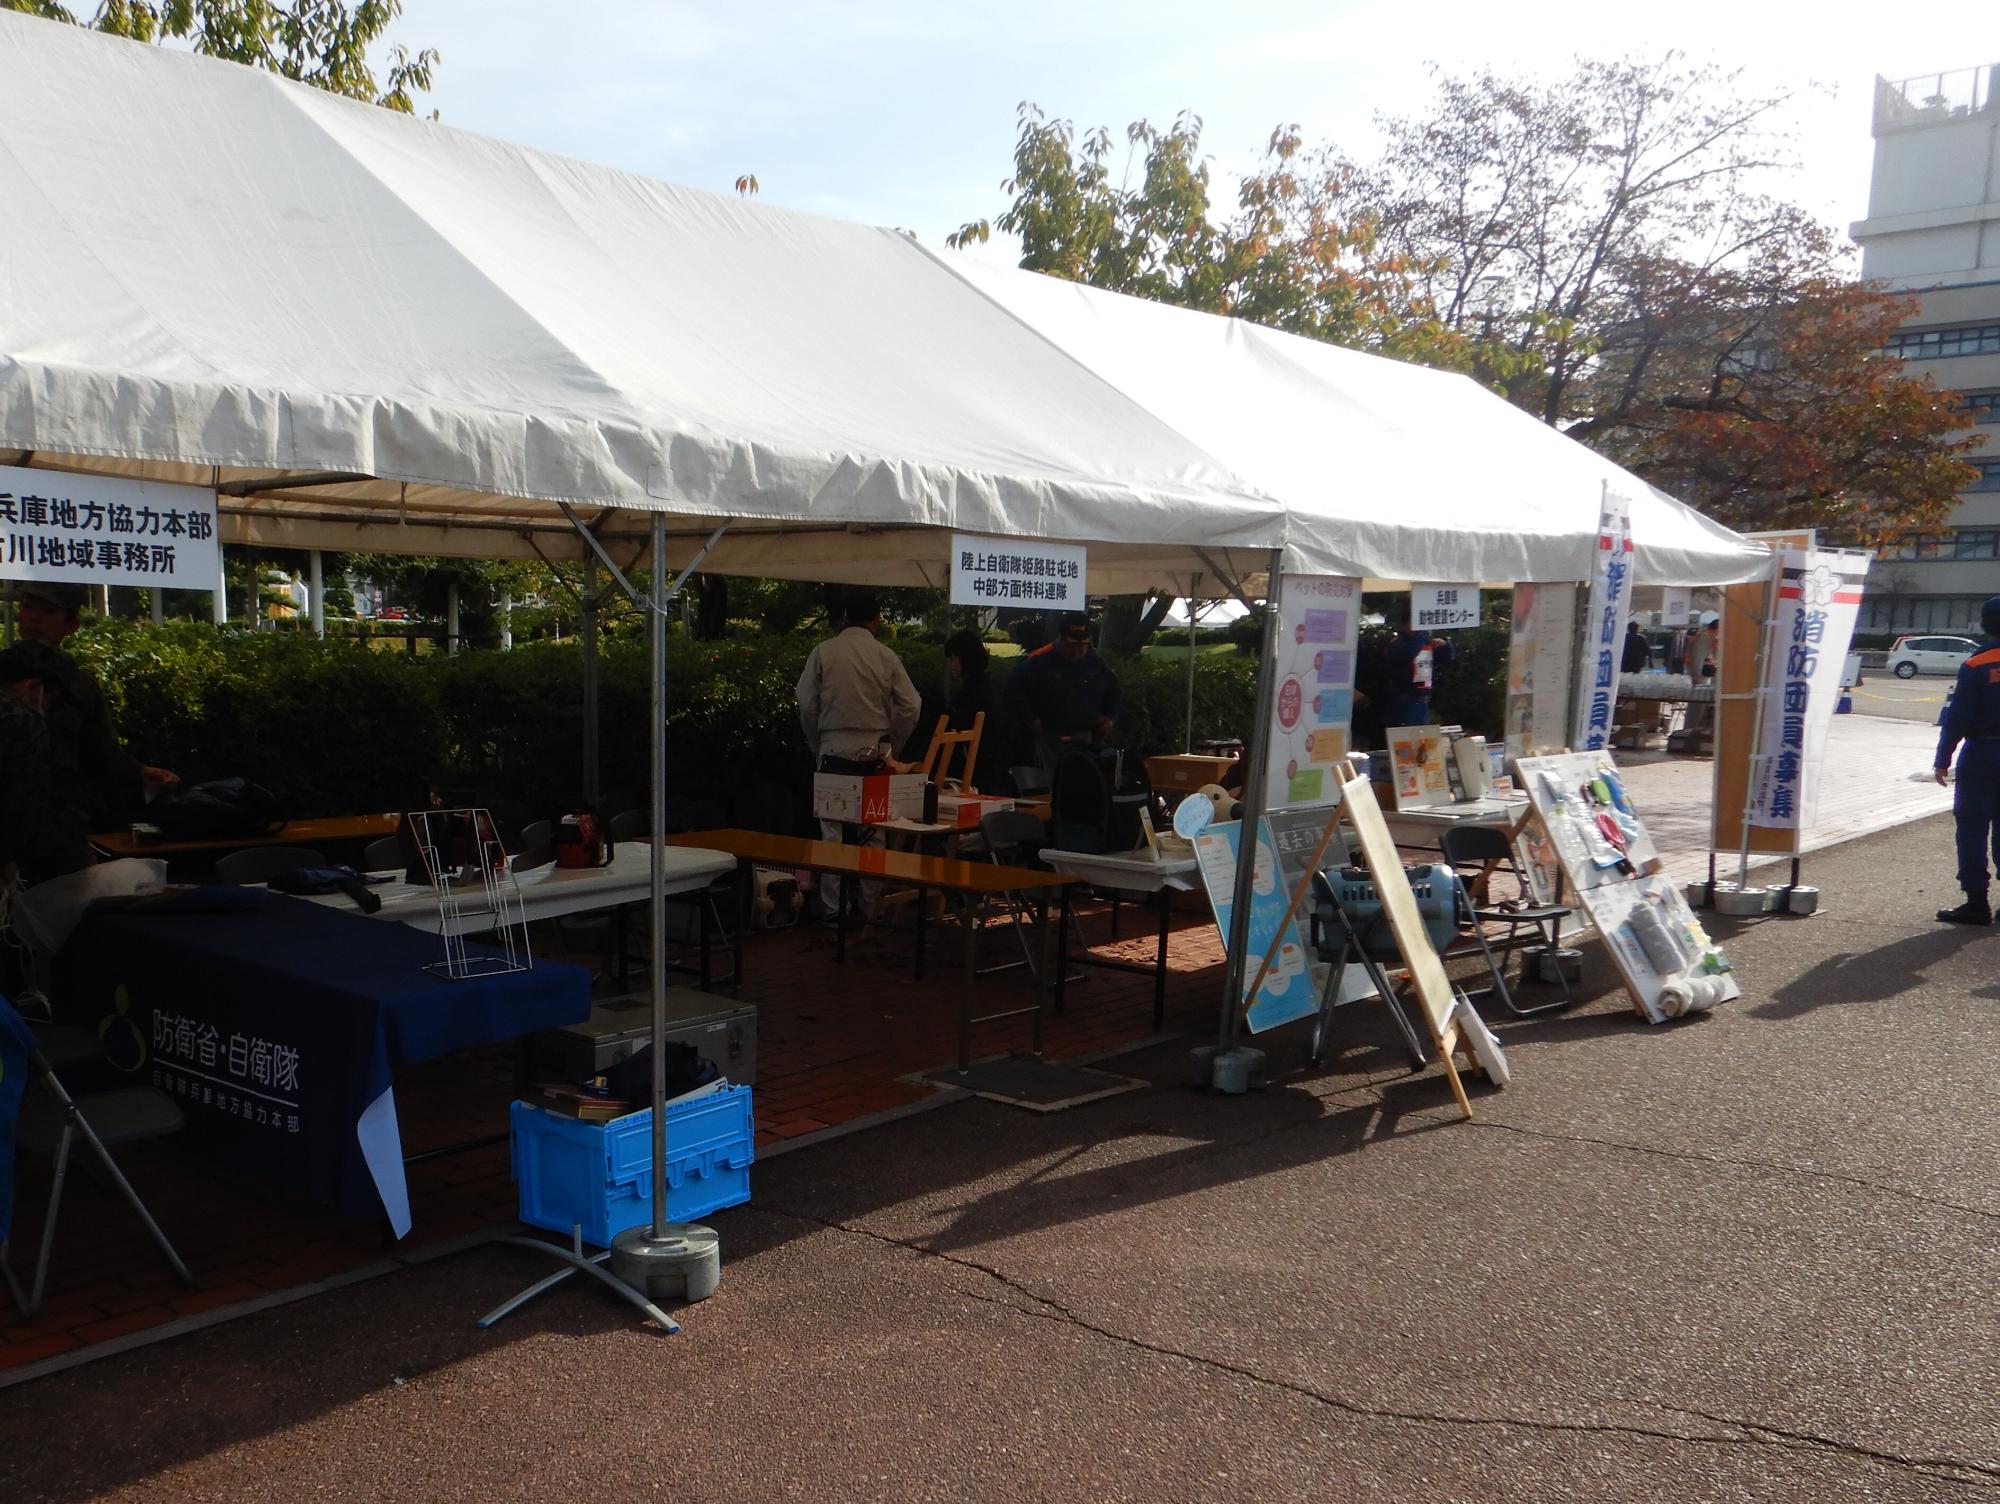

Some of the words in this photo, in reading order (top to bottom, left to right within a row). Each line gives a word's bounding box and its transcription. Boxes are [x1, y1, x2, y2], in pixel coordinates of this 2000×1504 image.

[0, 534, 176, 574] 川地域事務所
[961, 551, 1078, 579] 陸上自衛隊姫路駐屯地
[973, 577, 1067, 600] 中部方面特科連隊
[865, 798, 886, 820] A4
